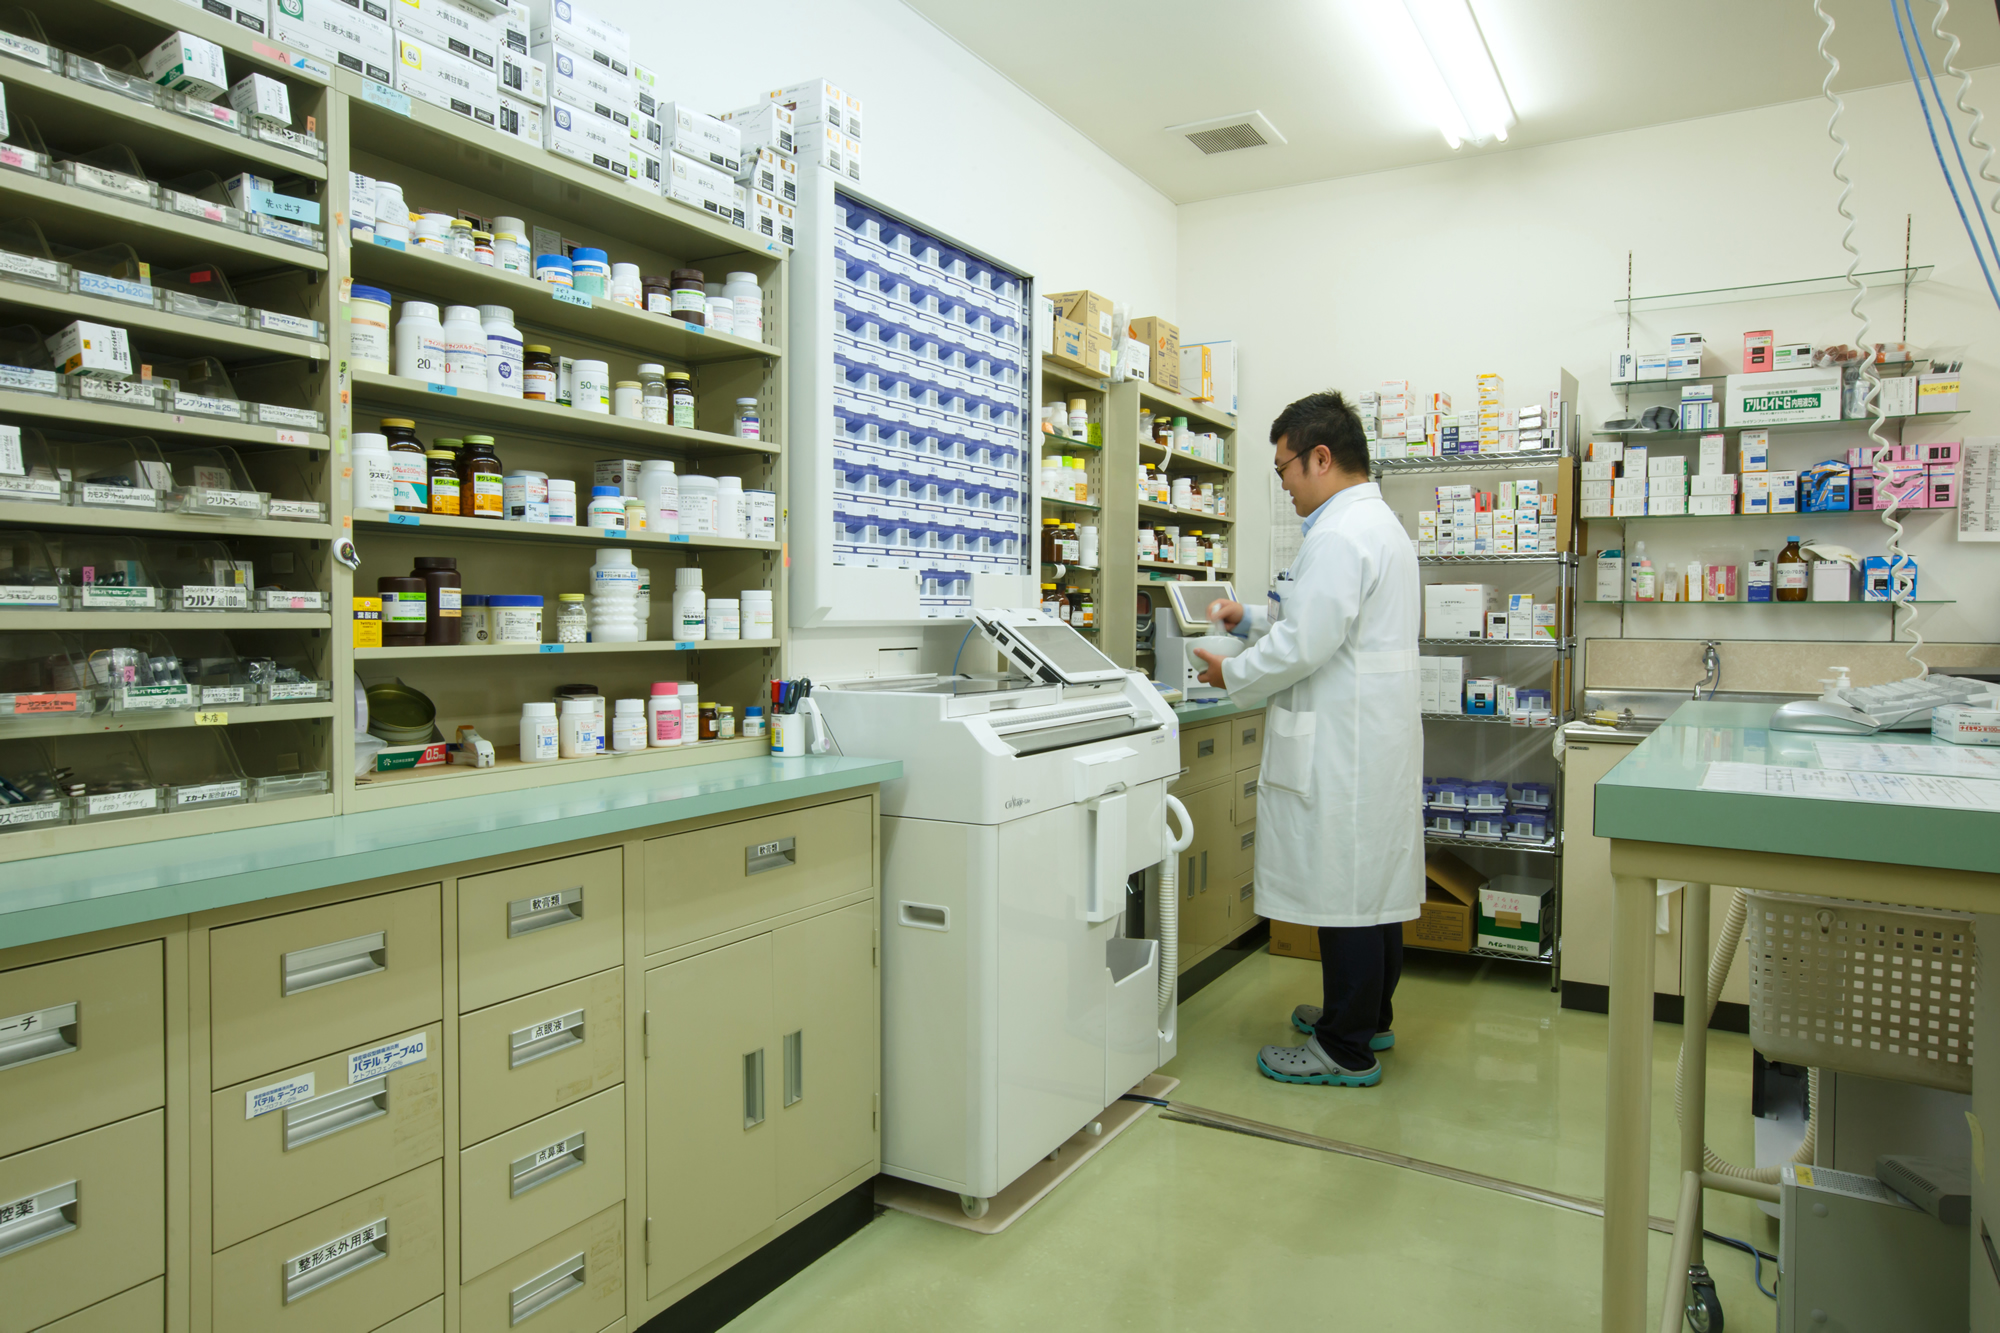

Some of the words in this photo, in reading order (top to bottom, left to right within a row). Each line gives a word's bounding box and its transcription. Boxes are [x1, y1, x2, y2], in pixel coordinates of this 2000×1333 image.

[278, 52, 287, 63] A
[265, 198, 301, 215] 先に出す
[1745, 396, 1819, 412] アルロイドG内用液5%
[425, 747, 446, 761] 0.5mg
[535, 1020, 562, 1038] 点眼液
[297, 1228, 376, 1273] 整形系外用薬
